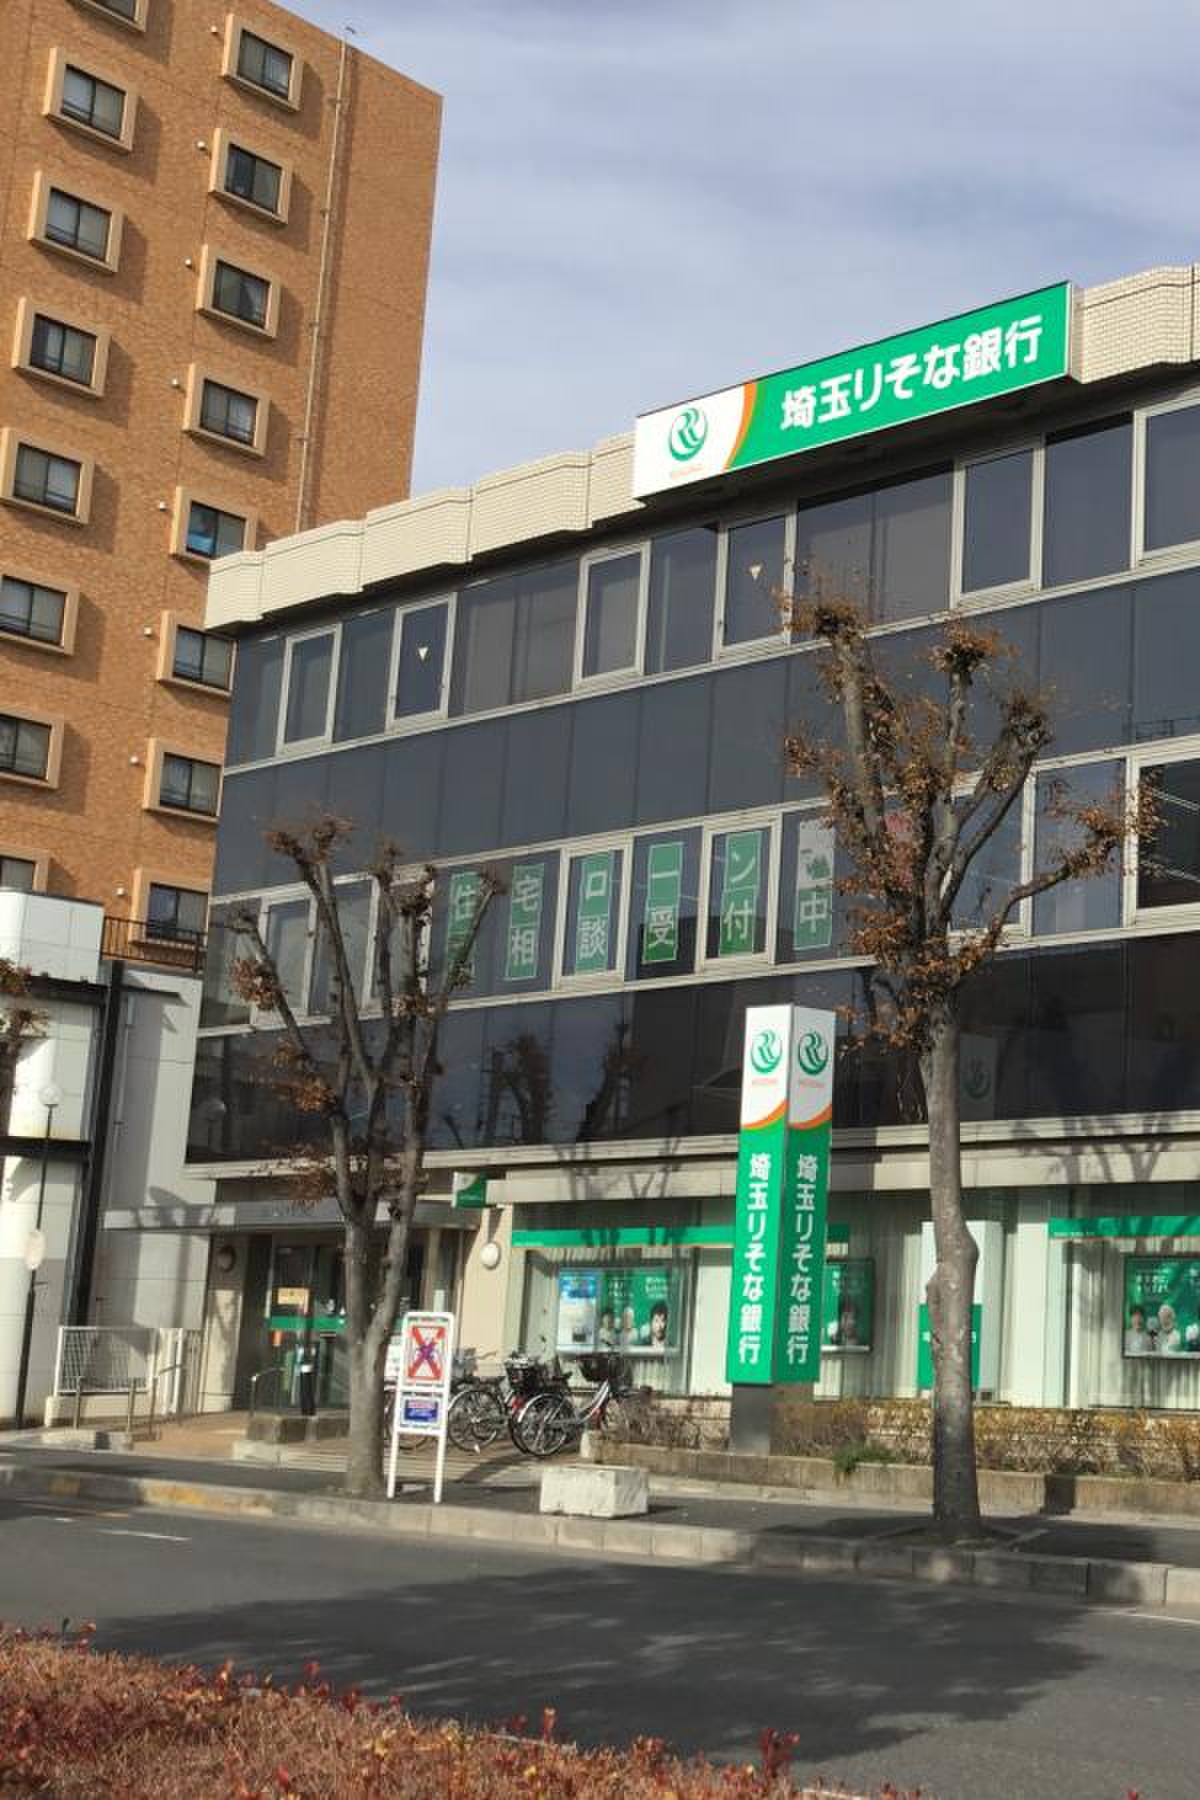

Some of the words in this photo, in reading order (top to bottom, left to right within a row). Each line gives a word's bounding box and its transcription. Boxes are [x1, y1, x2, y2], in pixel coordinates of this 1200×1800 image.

[780, 314, 1042, 430] 埼玉りそな銀行
[738, 1153, 771, 1365] 埼玉りそな銀行
[786, 1154, 820, 1365] 埼玉りそな銀行
